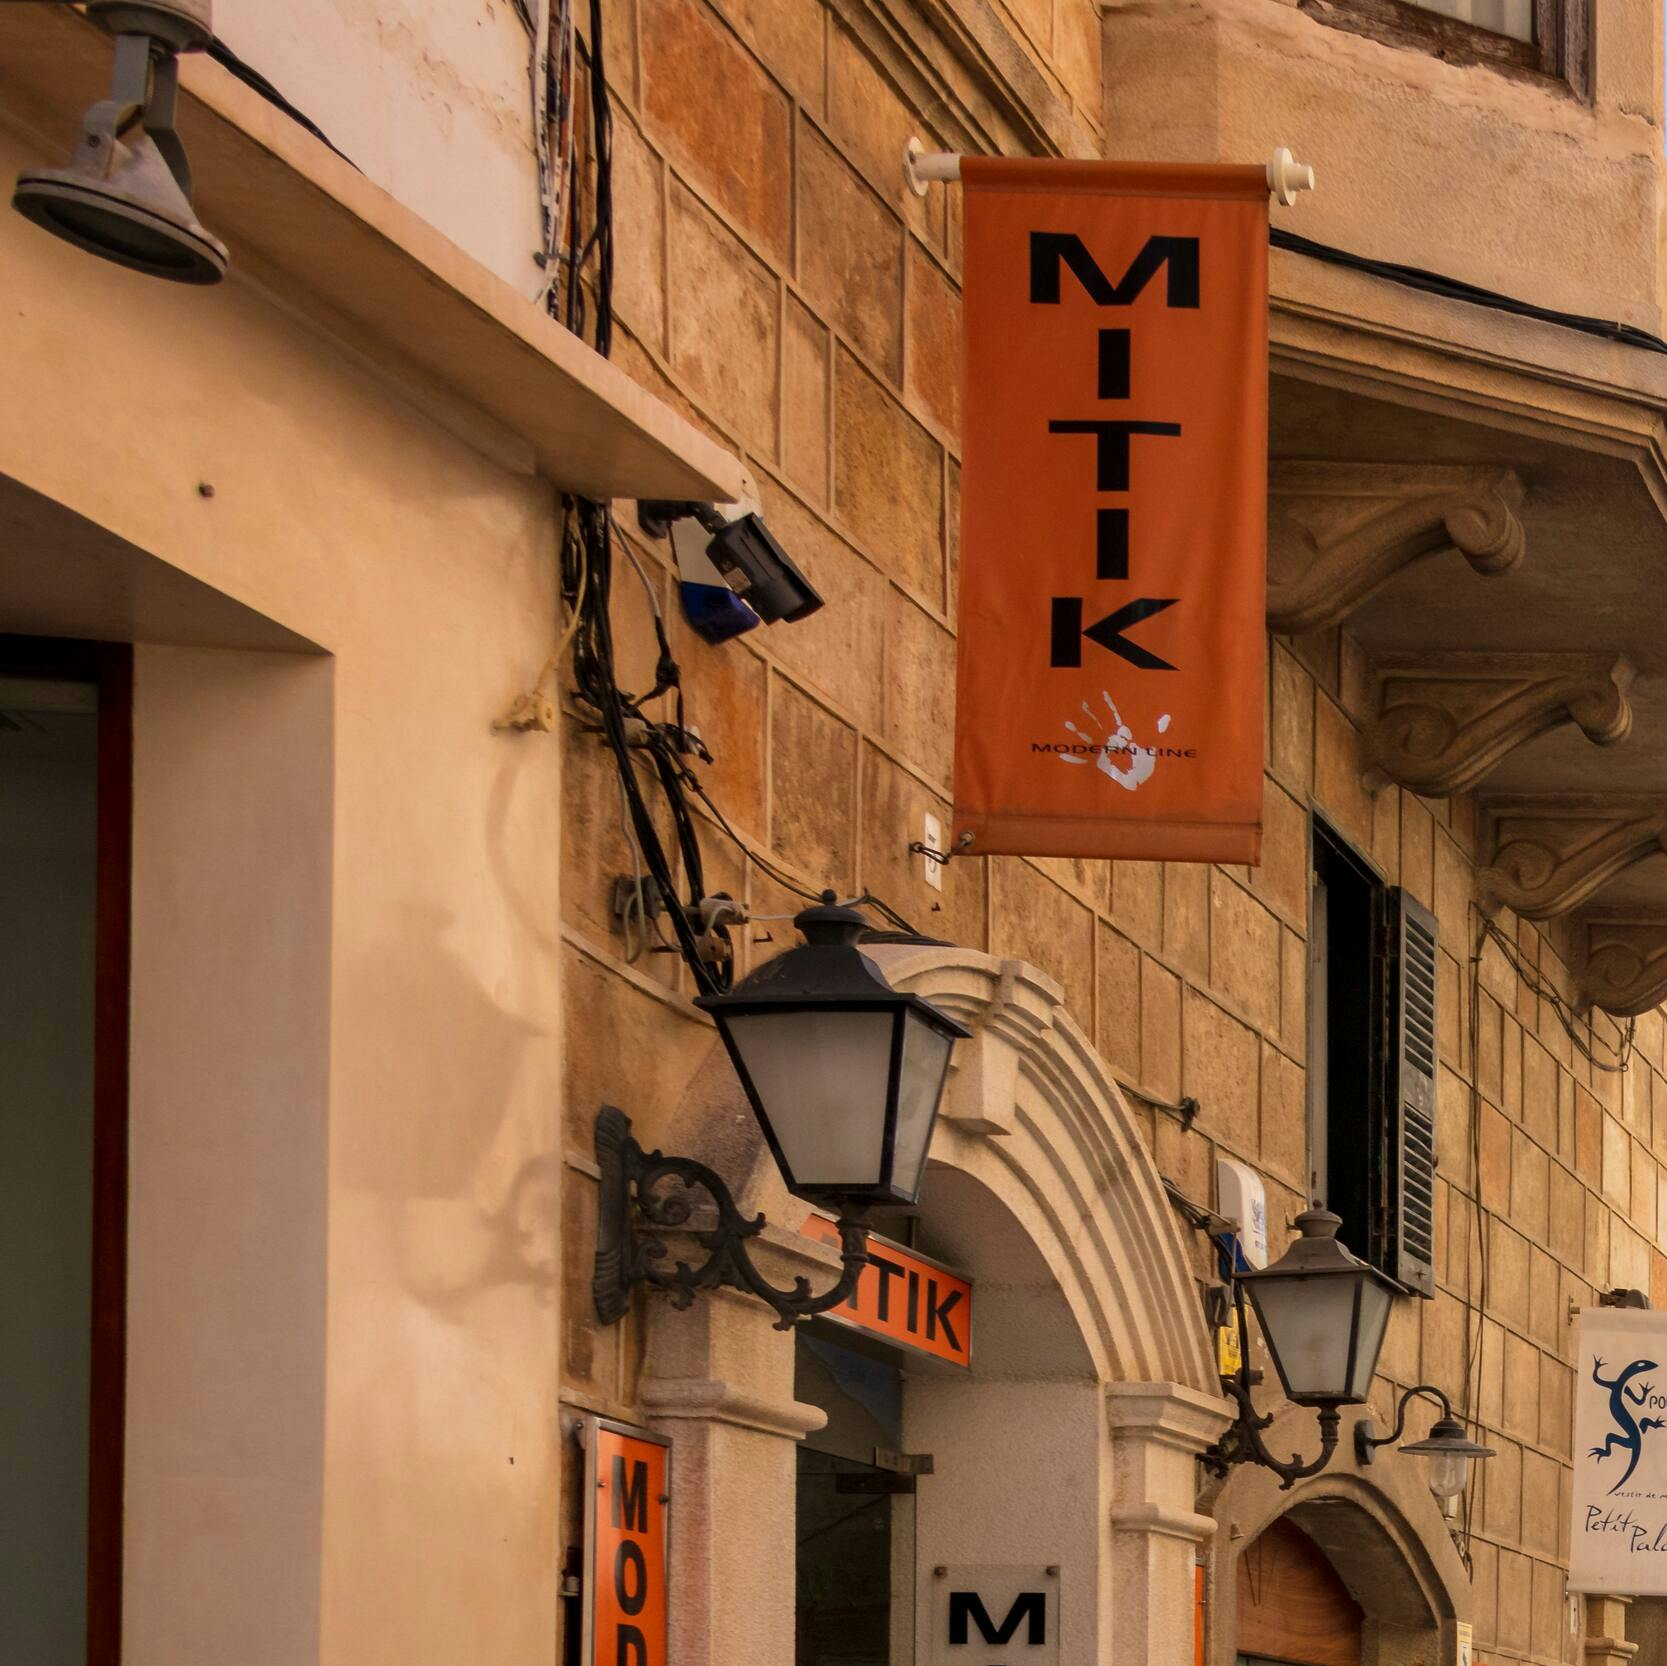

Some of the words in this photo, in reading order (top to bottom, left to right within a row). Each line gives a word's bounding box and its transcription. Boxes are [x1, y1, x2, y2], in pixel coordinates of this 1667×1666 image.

[1029, 231, 1200, 671] MITIK
[1031, 743, 1137, 756] MODERN
[1146, 746, 1198, 758] LINE
[1585, 1504, 1638, 1533] Petit
